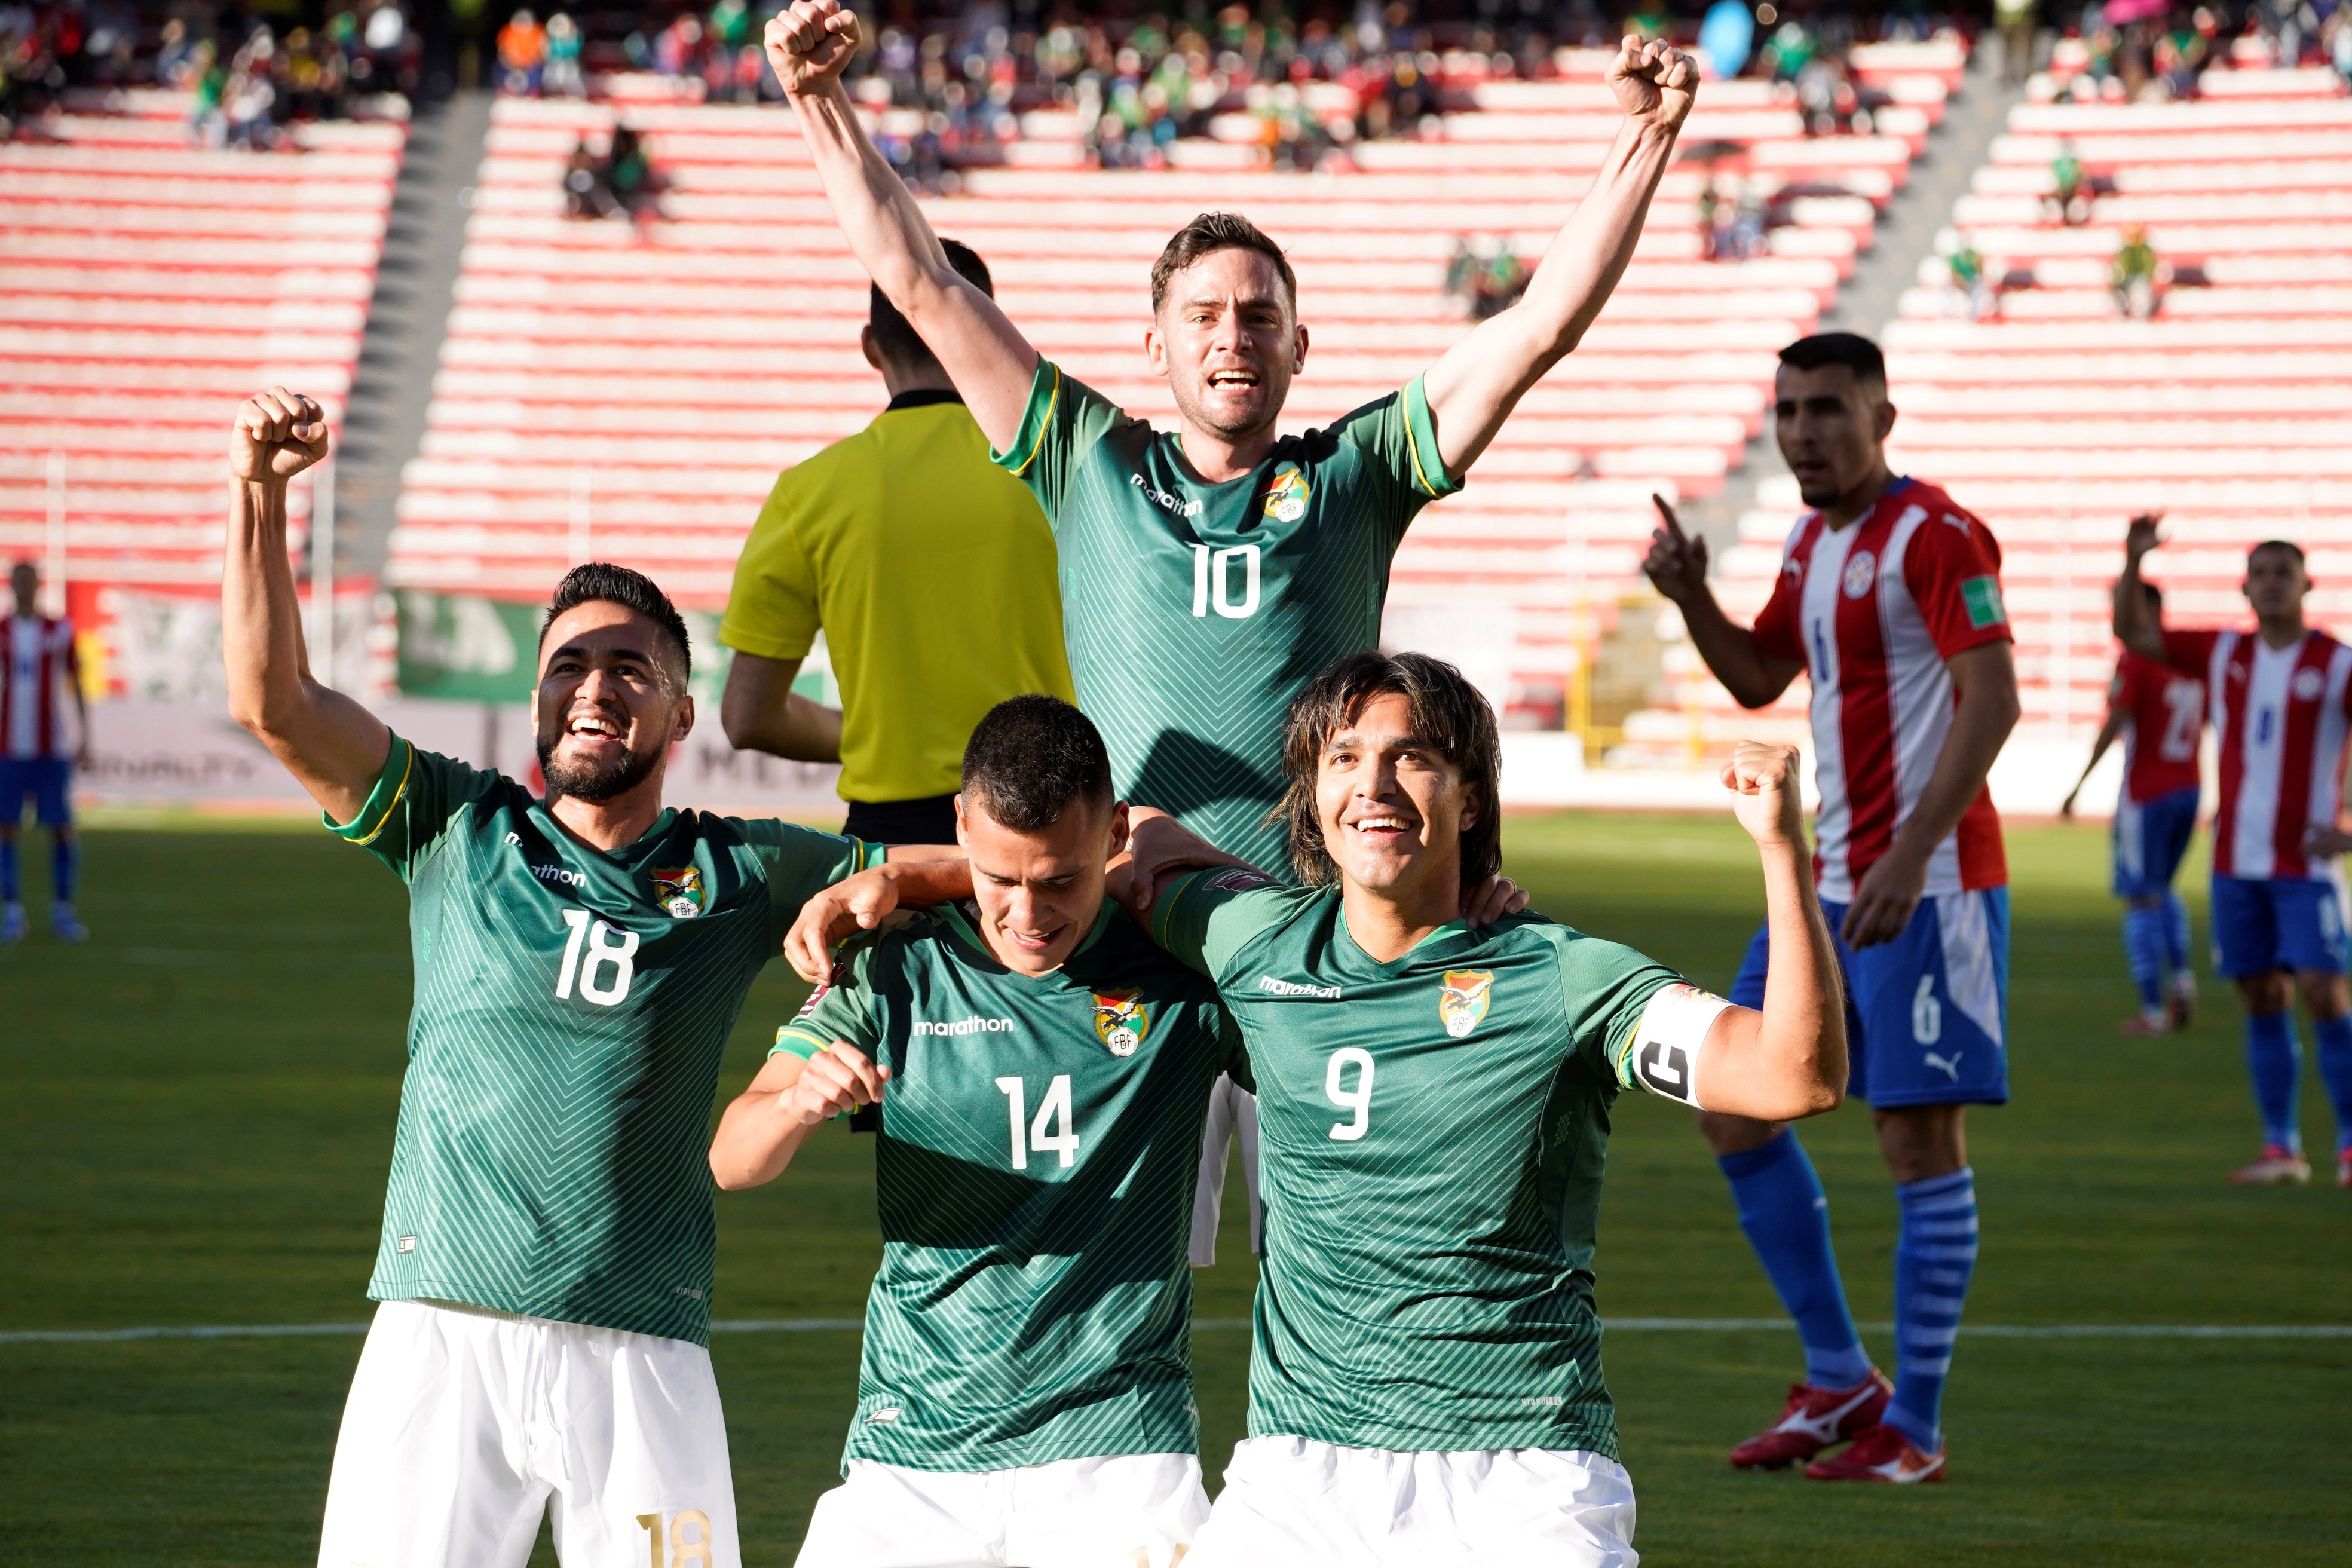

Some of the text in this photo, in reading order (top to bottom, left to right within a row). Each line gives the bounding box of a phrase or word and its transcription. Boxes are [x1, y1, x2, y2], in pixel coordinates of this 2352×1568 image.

[1130, 473, 1203, 517] marathon
[1282, 503, 1297, 517] FBF
[1185, 540, 1261, 619] 10
[504, 832, 586, 887] mathon
[675, 903, 692, 916] FBF
[555, 909, 640, 1006] 18
[1259, 975, 1342, 999] marathon
[1913, 973, 1942, 1046] 6
[914, 1016, 1013, 1036] marathon
[1114, 1034, 1132, 1049] FBF
[1452, 1016, 1471, 1031] FBF
[1325, 1047, 1375, 1141] 9
[1640, 1040, 1689, 1101] C
[994, 1074, 1080, 1170] 14
[636, 1509, 712, 1568] 18
